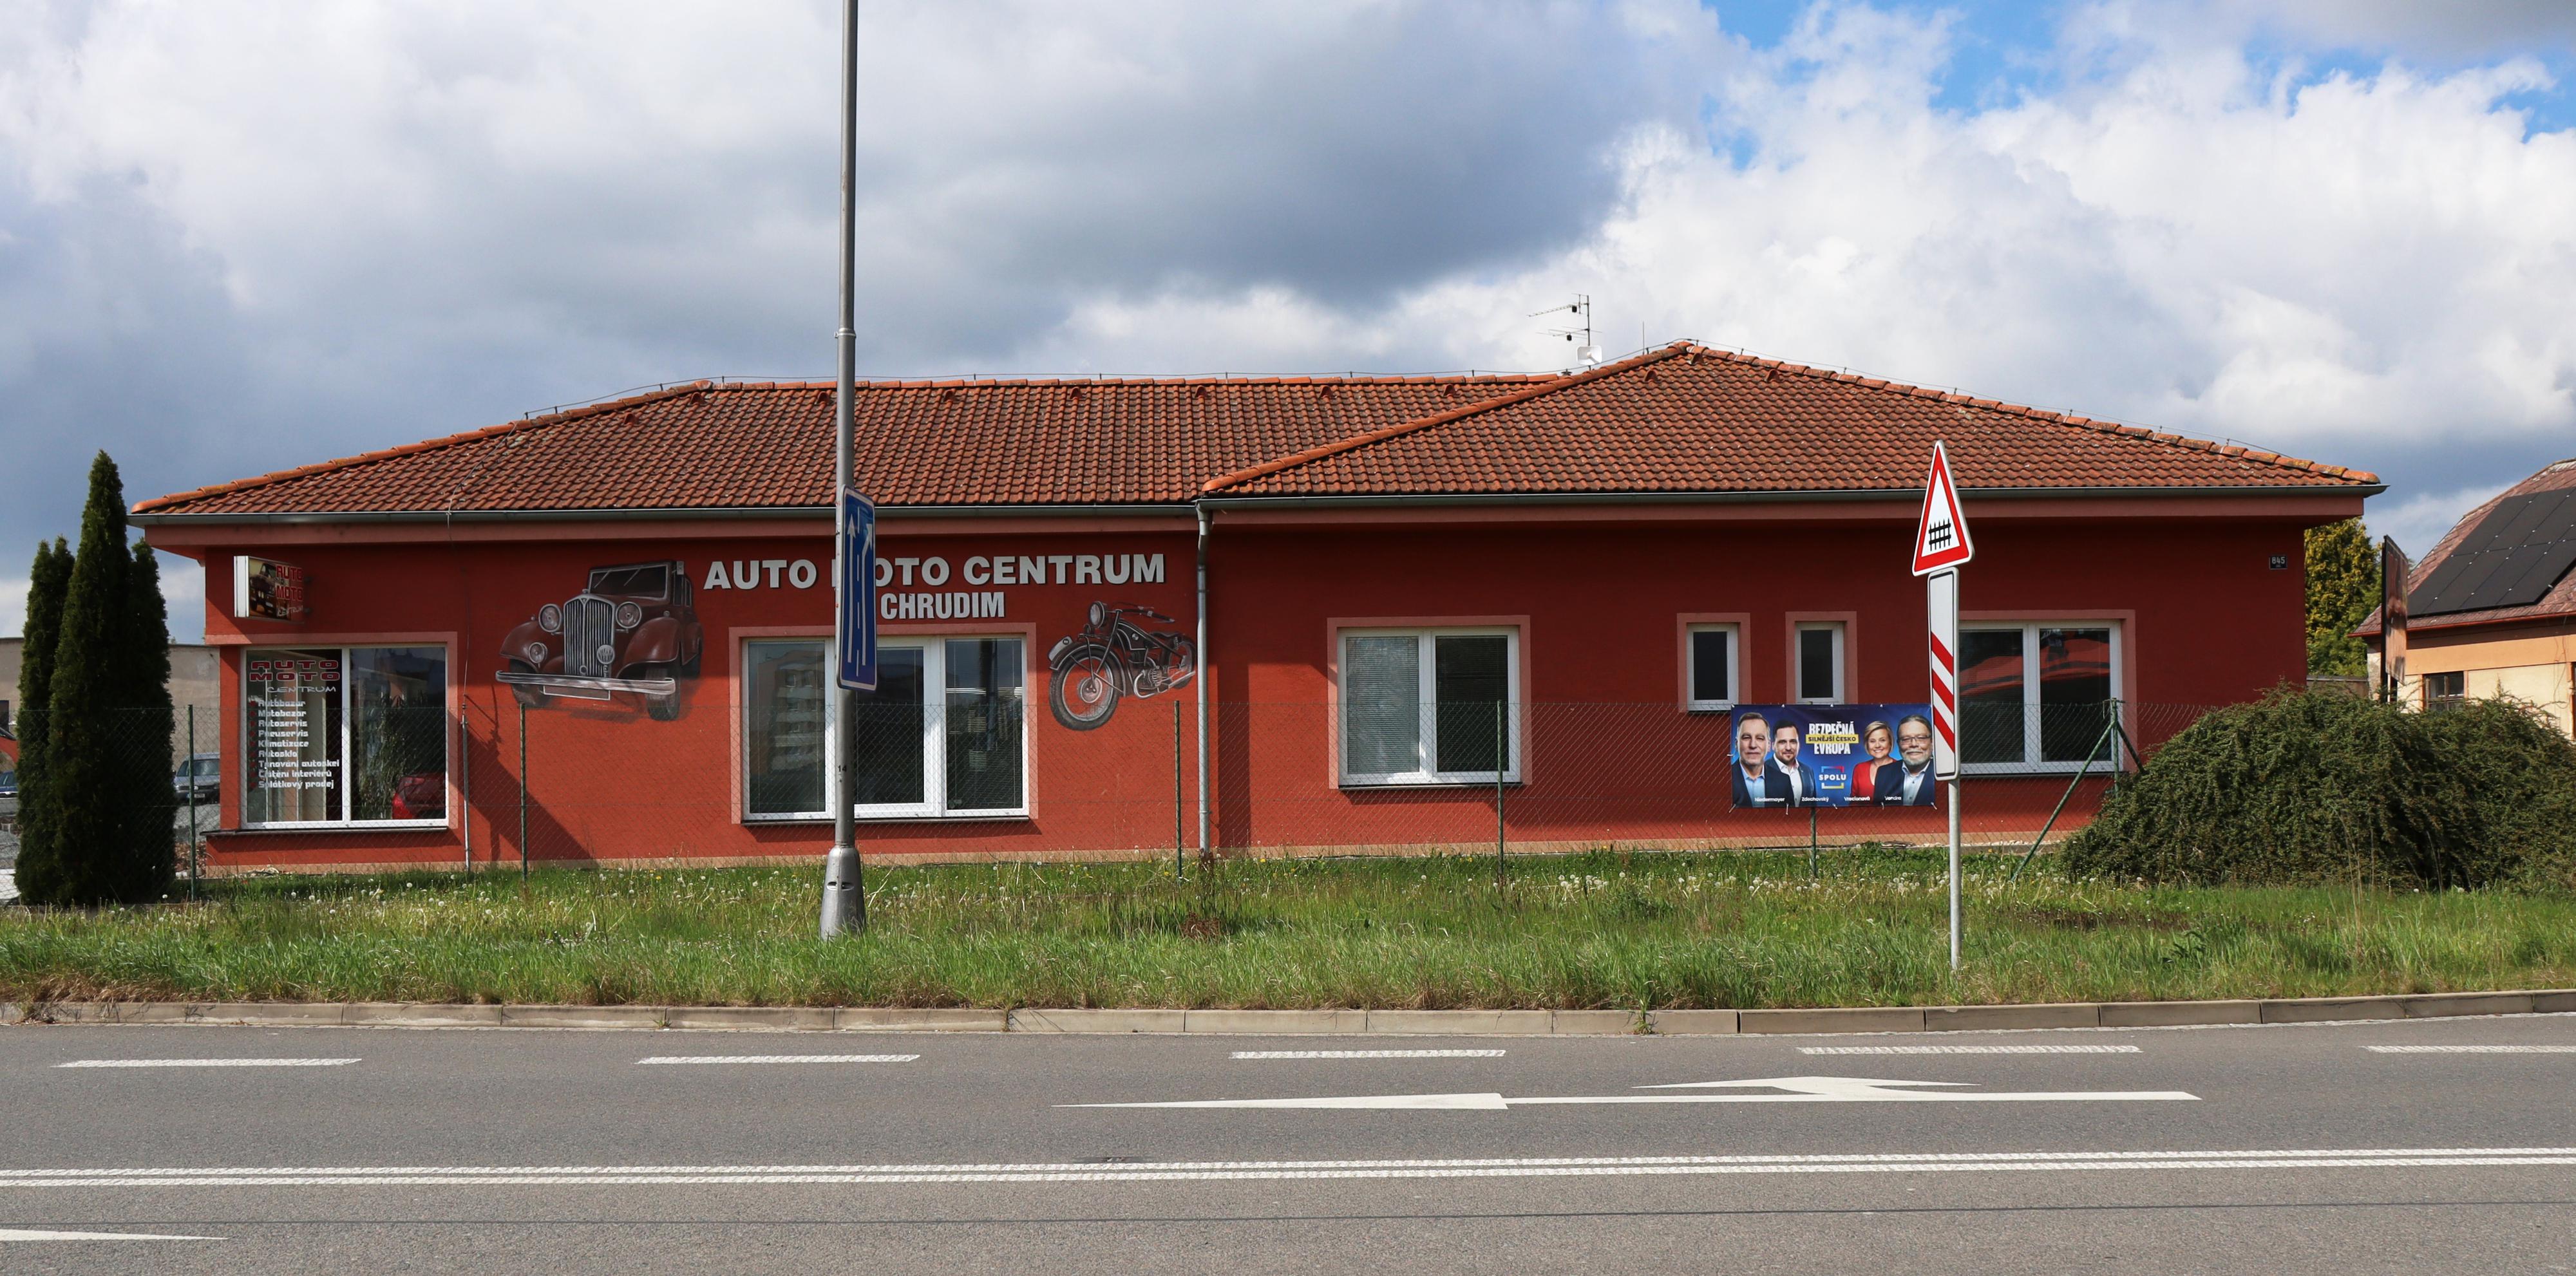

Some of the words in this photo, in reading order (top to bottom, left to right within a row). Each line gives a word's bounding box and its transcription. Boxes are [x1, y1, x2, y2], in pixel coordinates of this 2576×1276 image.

[276, 565, 303, 582] AUTO
[703, 559, 817, 590] AUTO
[831, 556, 950, 587] OTO
[963, 554, 1165, 585] CENTRUM
[276, 585, 303, 601] MOTO
[880, 592, 1005, 619] CHRUDIM
[251, 660, 339, 670] AUTO
[249, 671, 340, 682] MOTO
[1808, 721, 1855, 735] BEZPEČNÁ
[1814, 743, 1851, 755] EVROPA
[838, 764, 847, 773] 14
[305, 780, 334, 790] prodej
